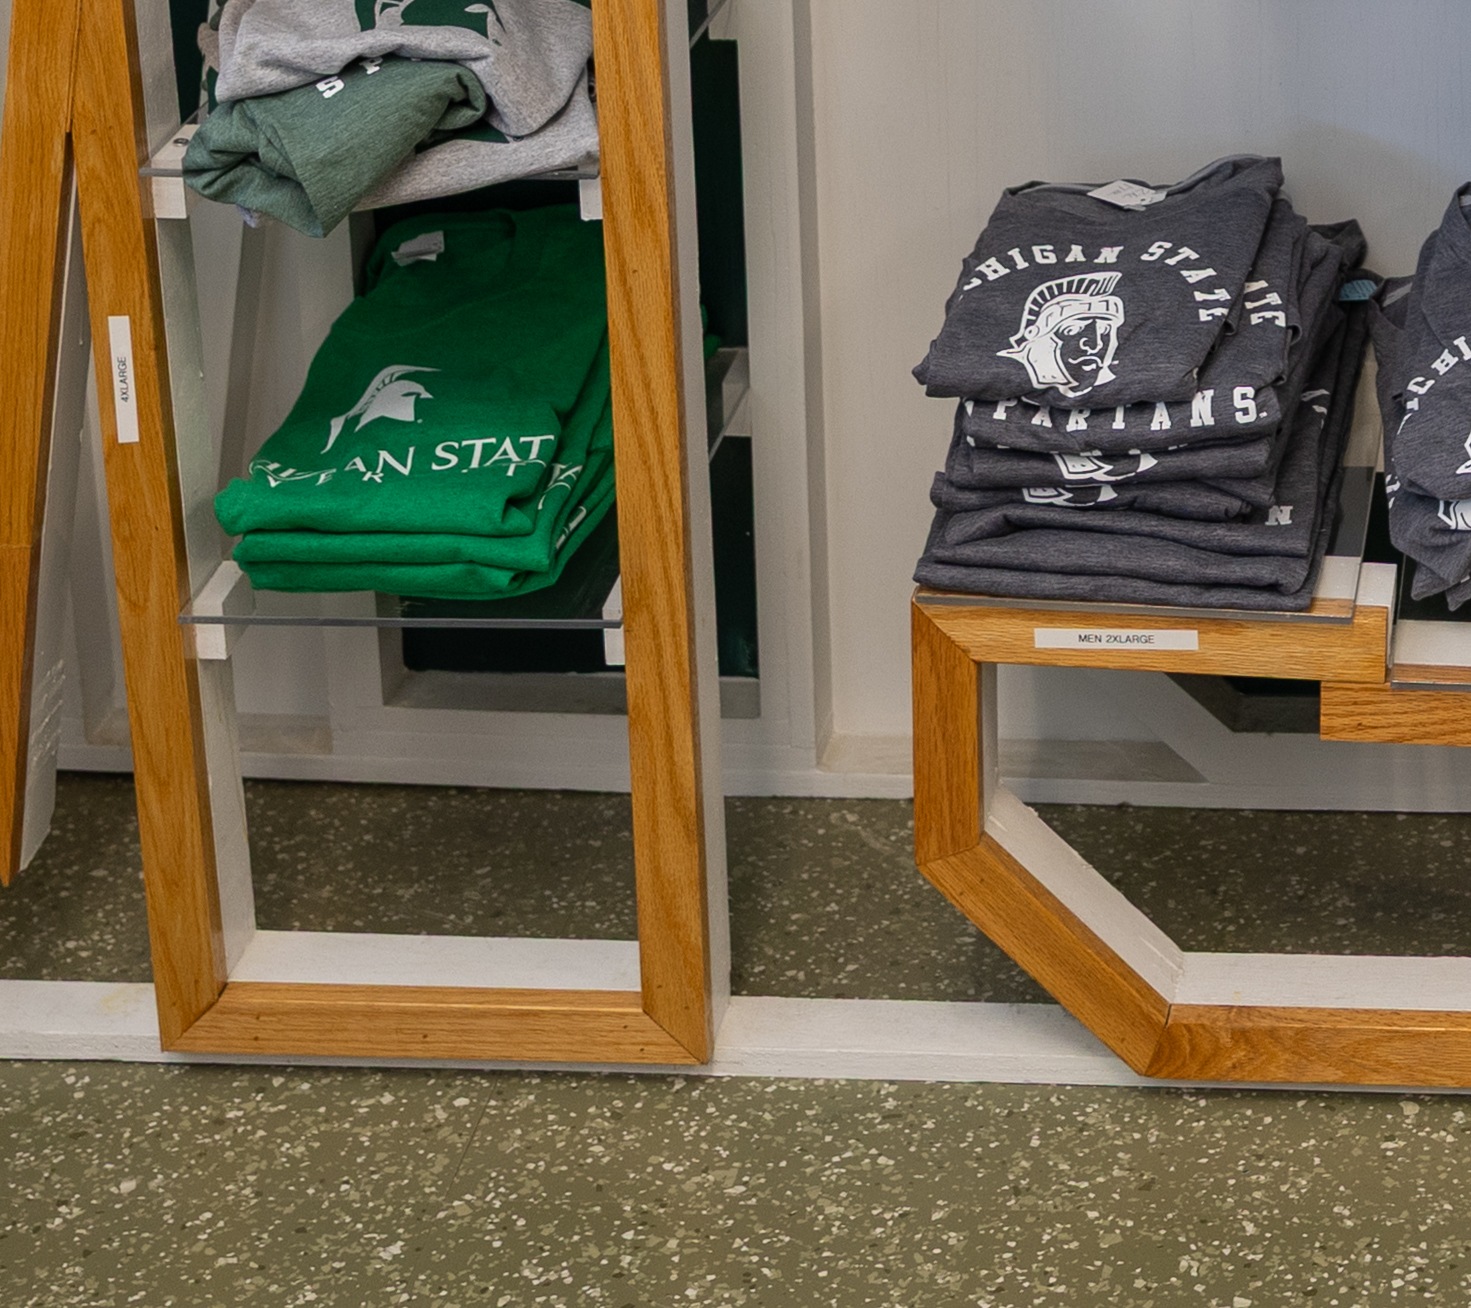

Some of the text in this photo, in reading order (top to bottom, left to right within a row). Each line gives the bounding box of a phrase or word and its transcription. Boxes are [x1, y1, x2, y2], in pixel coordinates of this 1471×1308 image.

[116, 357, 130, 403] 4XLARGE
[1078, 634, 1155, 645] MEN 2XLARGE
